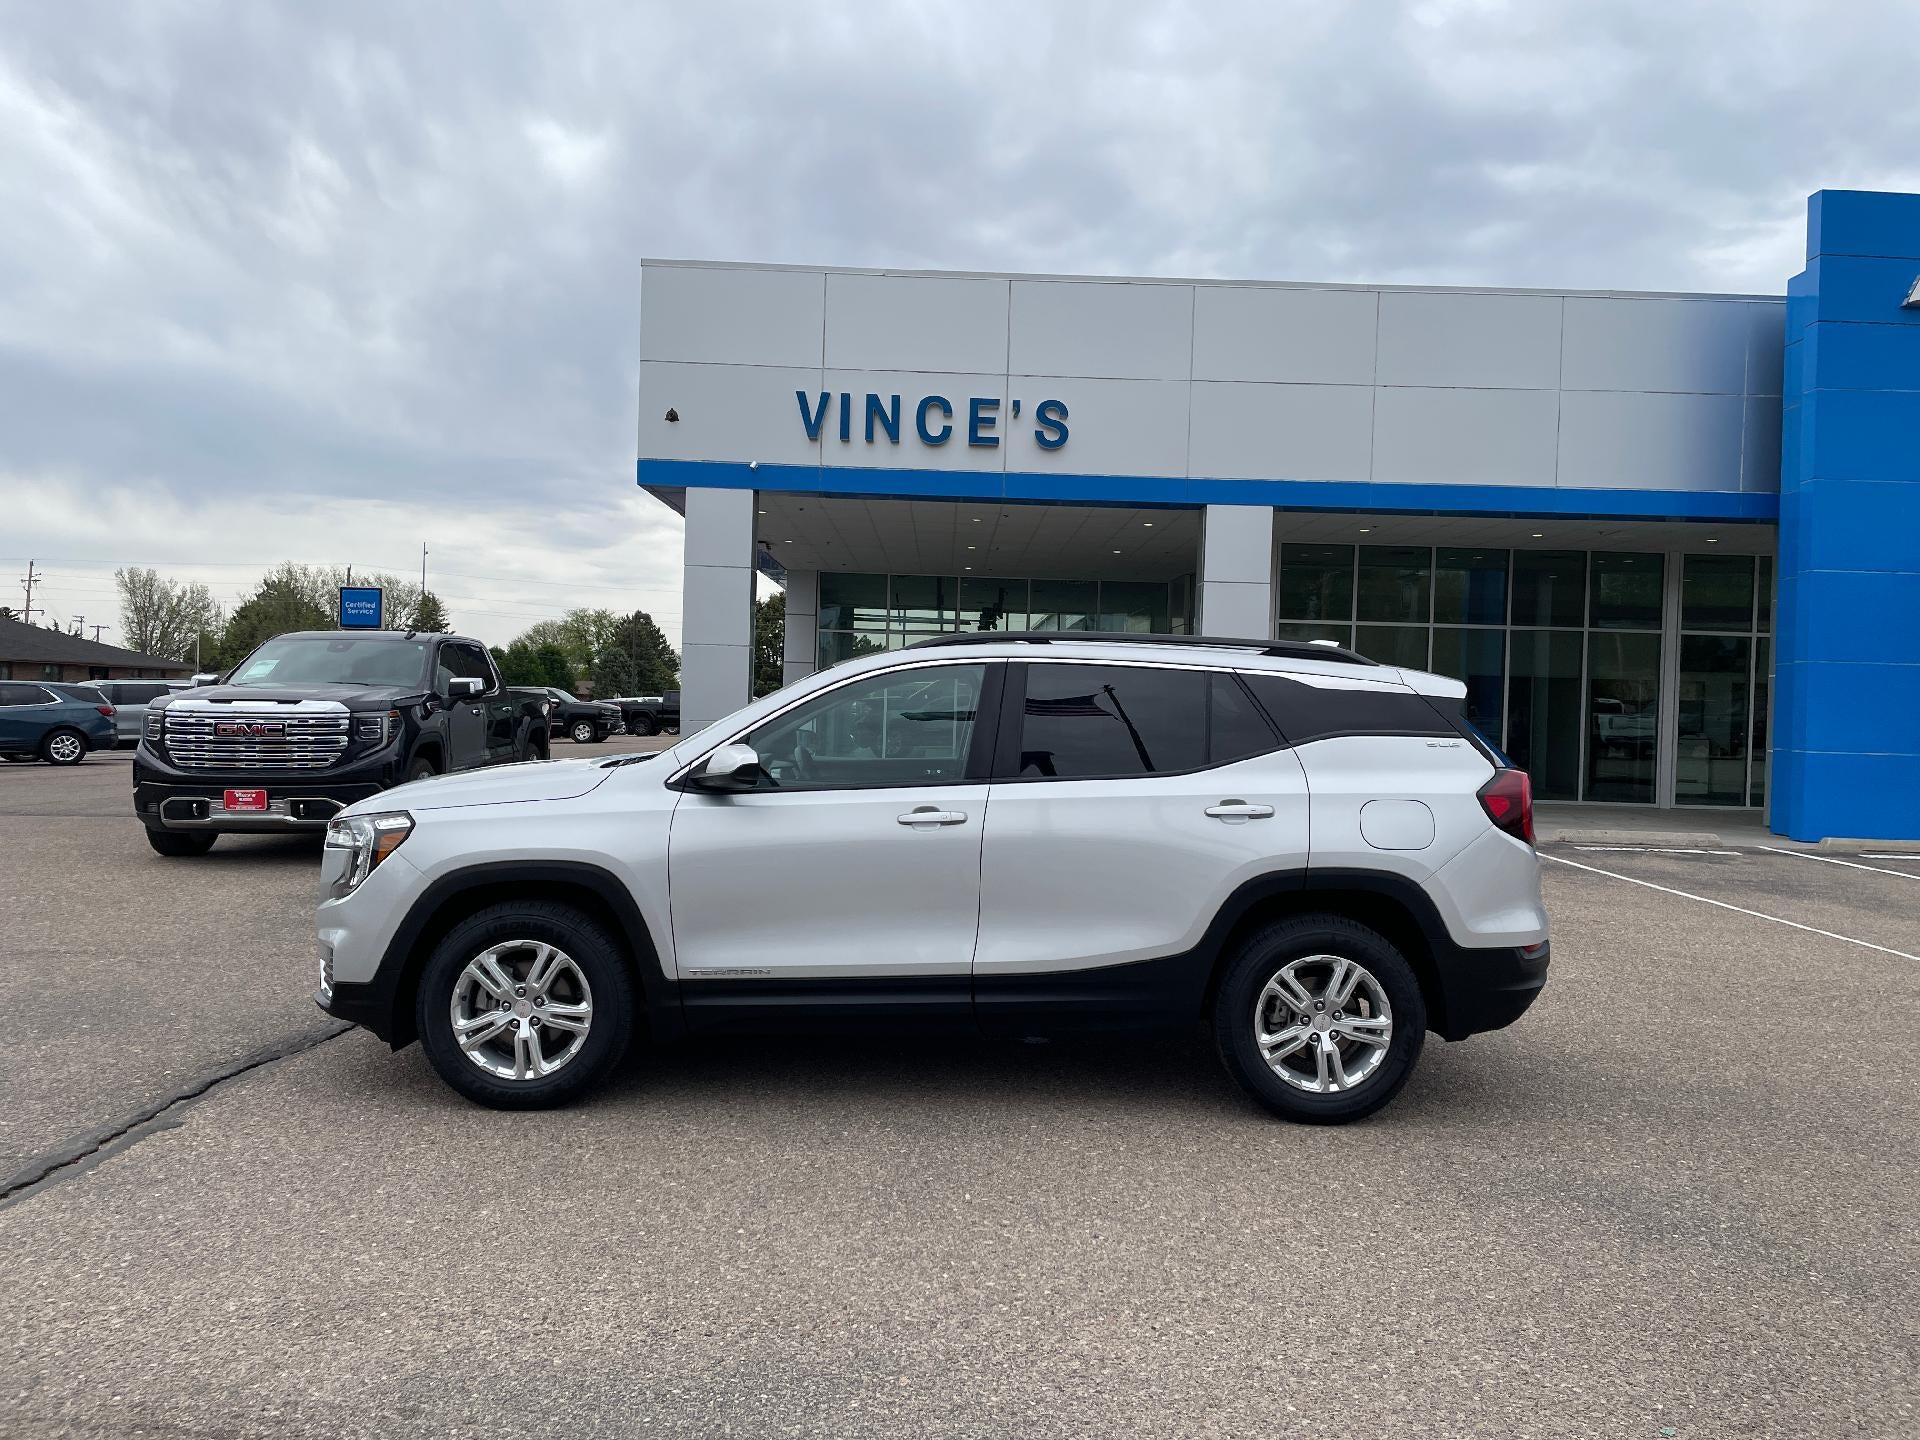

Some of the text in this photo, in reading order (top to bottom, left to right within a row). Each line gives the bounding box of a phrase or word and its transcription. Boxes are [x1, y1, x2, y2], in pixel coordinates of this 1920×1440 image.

[796, 391, 1069, 450] VINCE'S
[345, 601, 376, 609] Certified
[216, 725, 282, 737] GMC
